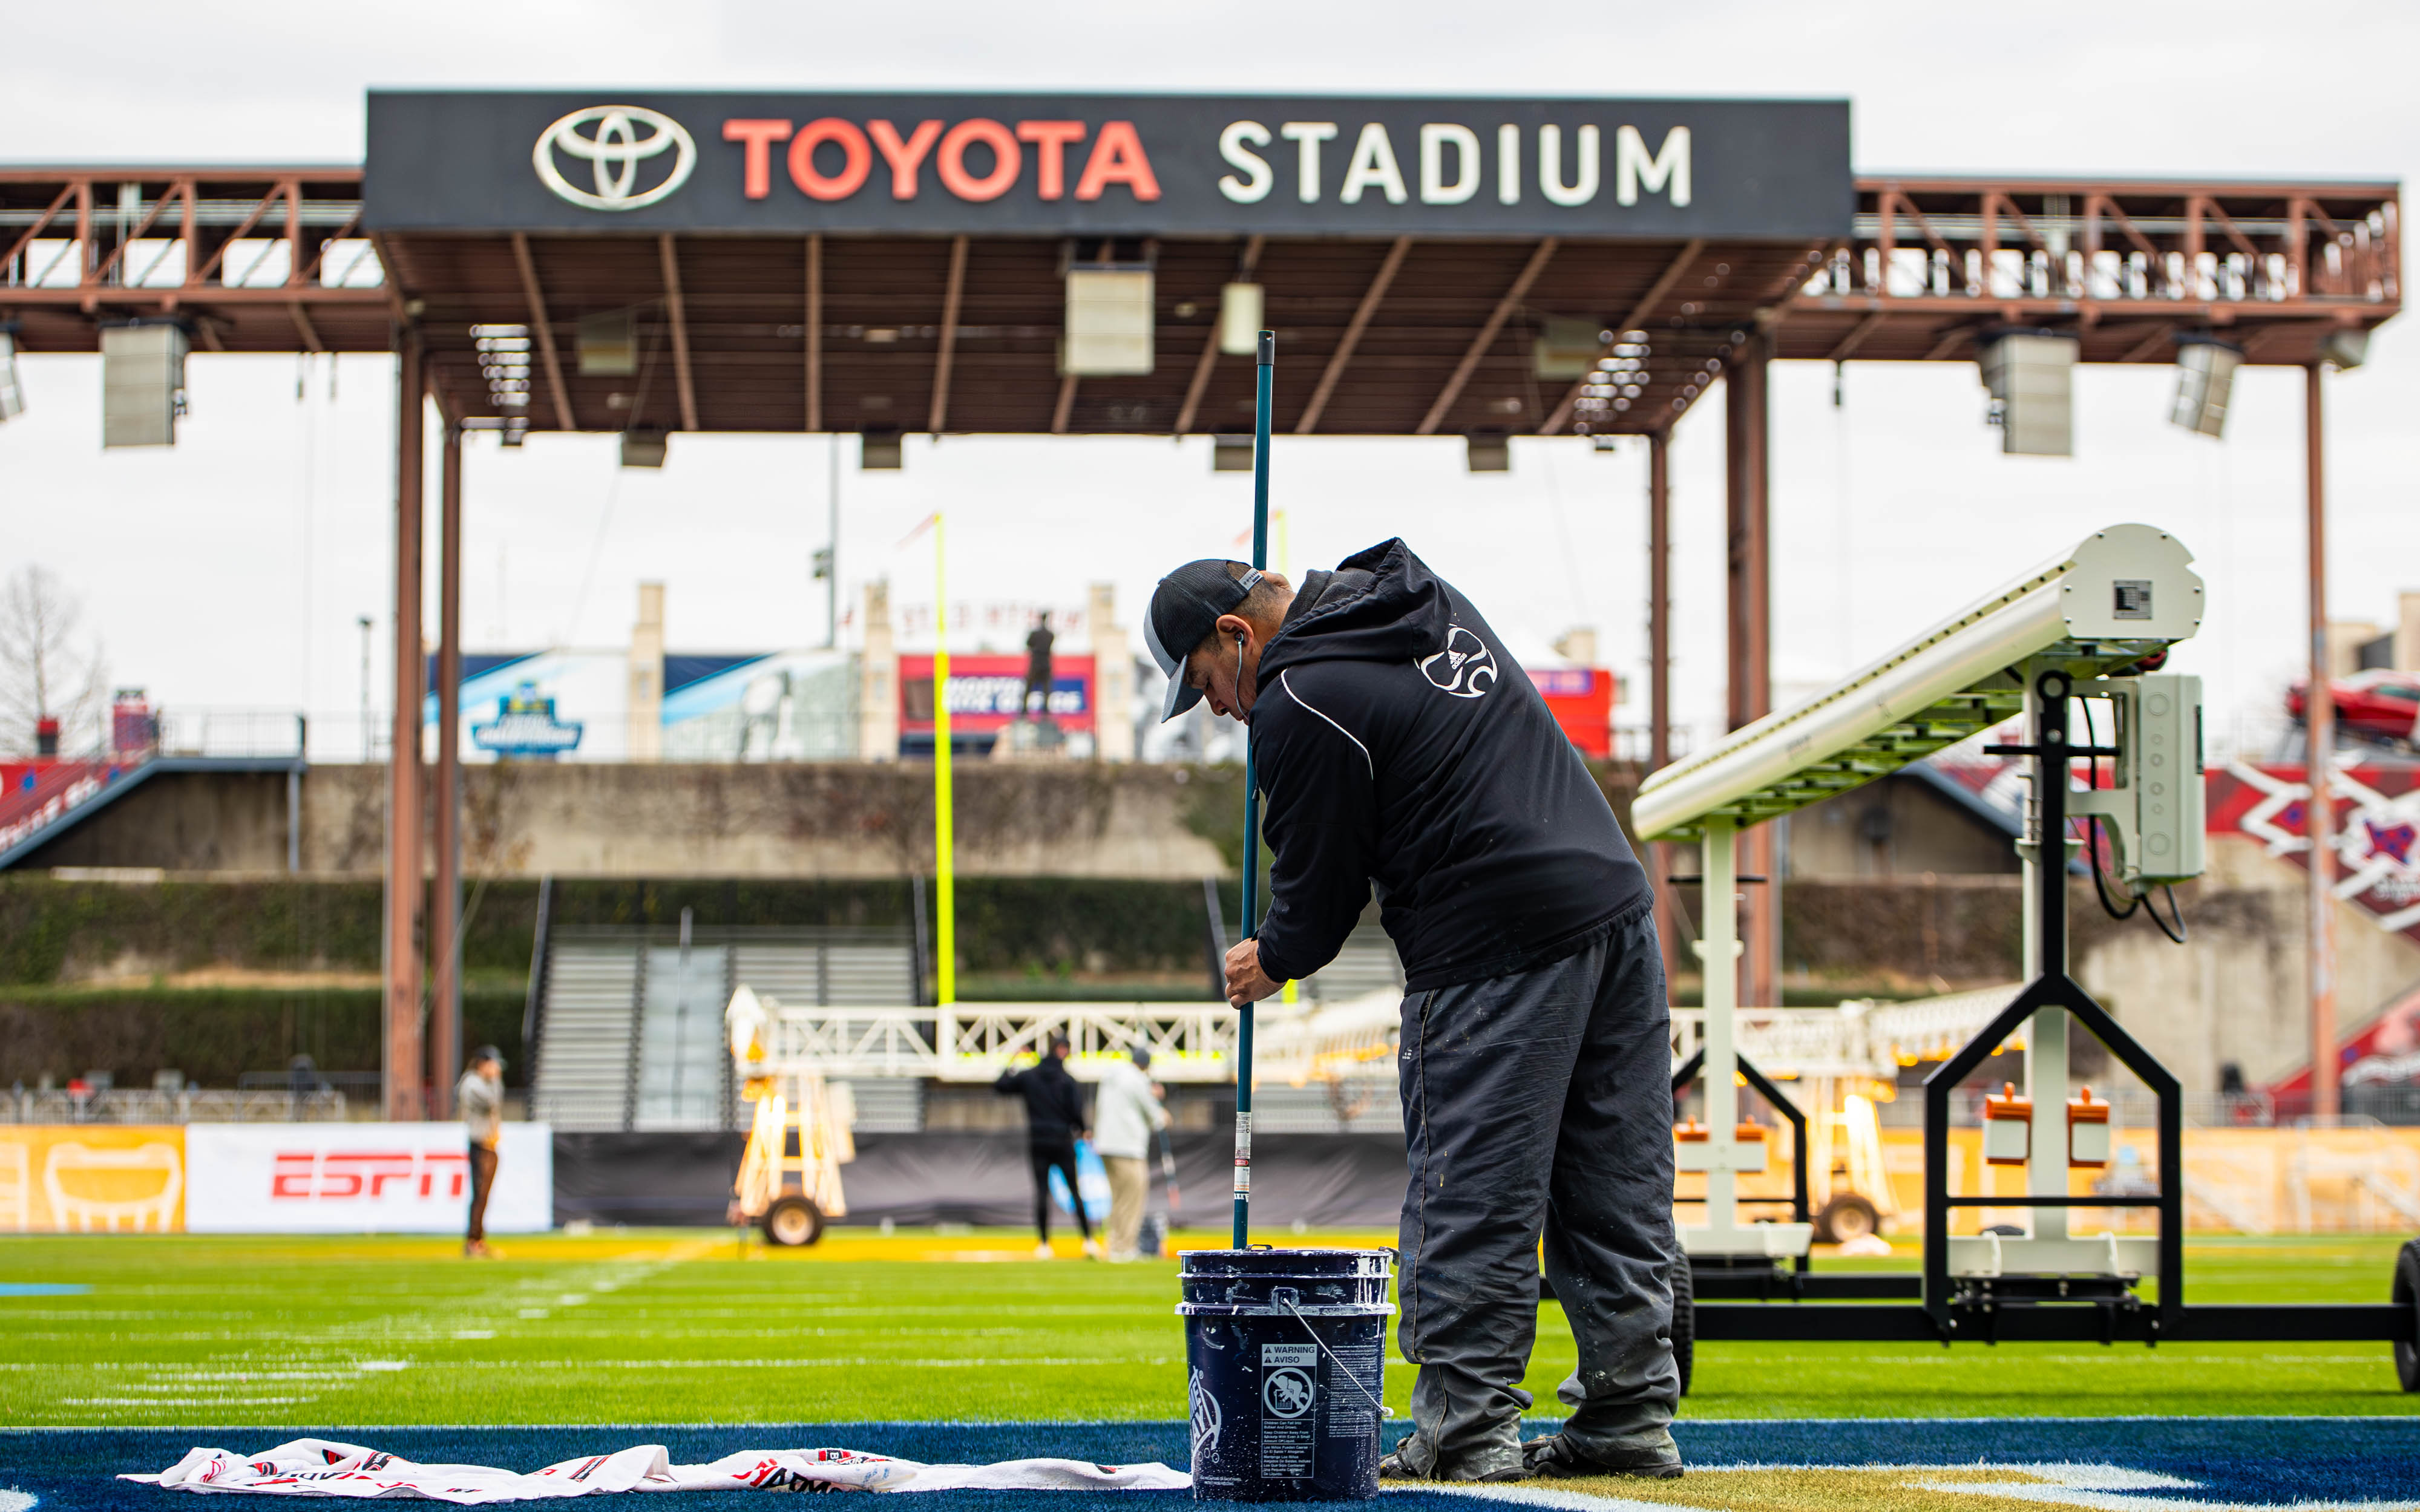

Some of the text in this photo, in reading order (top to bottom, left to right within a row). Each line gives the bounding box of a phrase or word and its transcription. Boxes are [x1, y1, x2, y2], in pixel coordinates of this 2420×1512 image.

[722, 117, 1692, 206] TOYOTA STADIUM
[1451, 652, 1467, 670] adidas
[272, 1152, 467, 1197] ESPN
